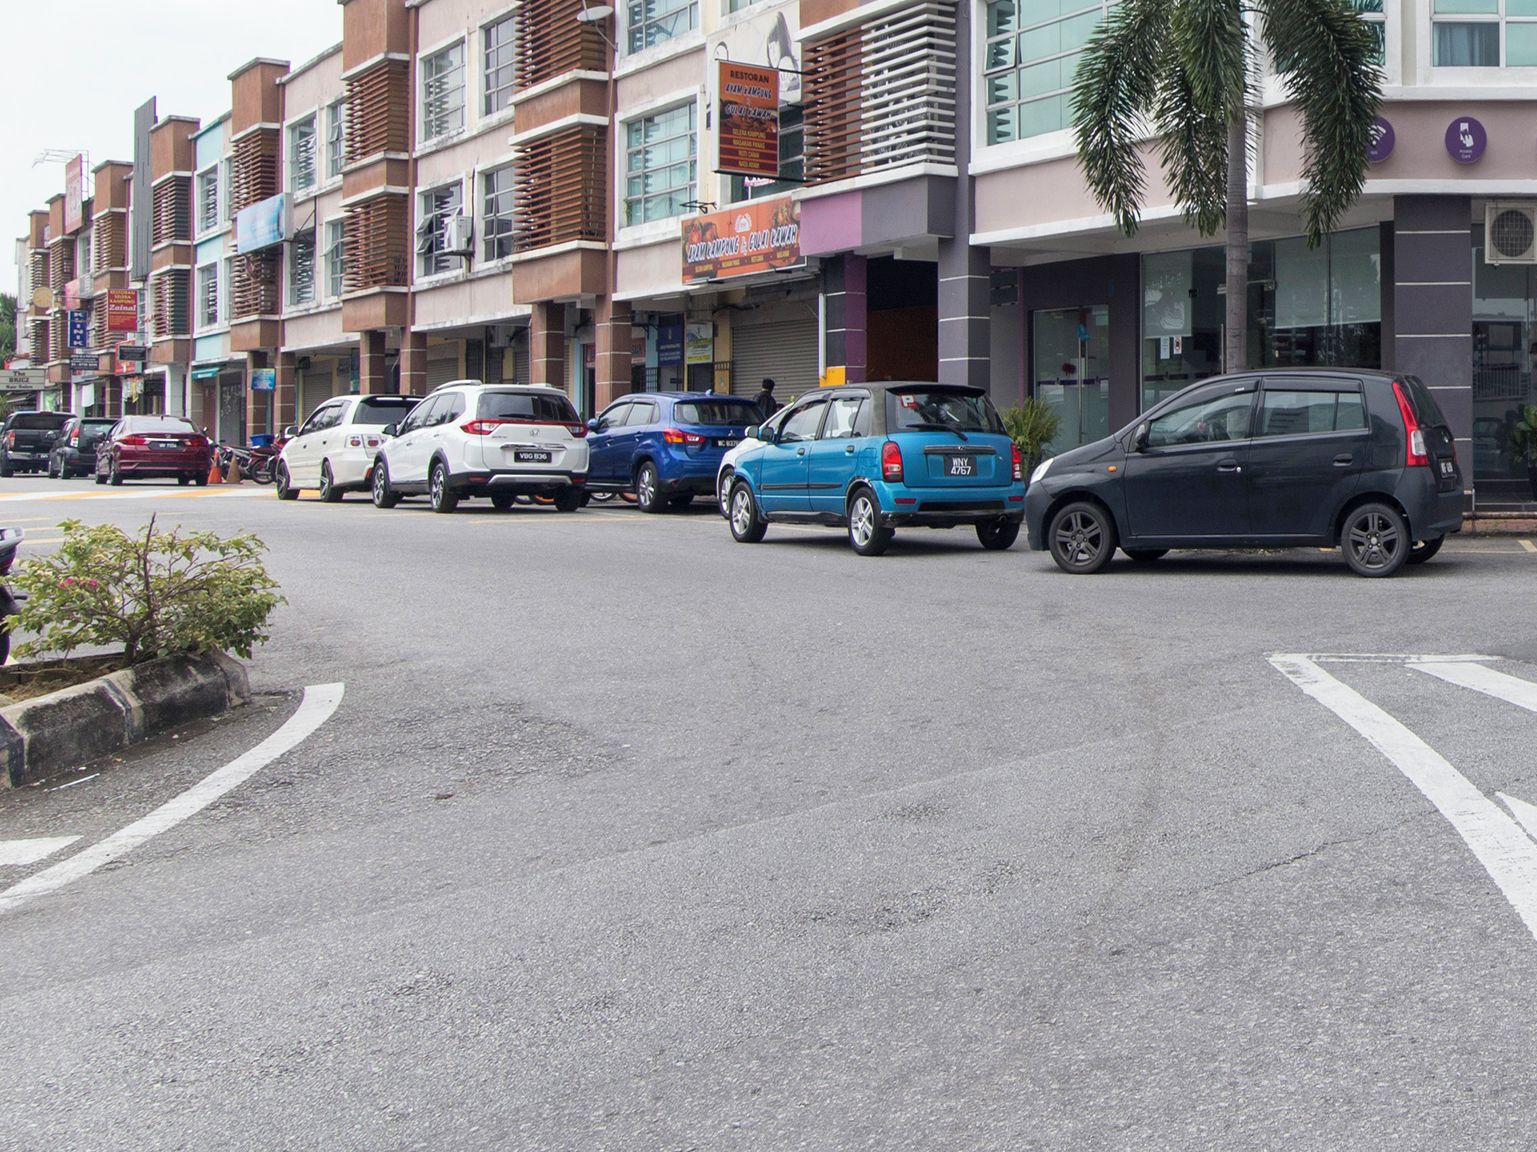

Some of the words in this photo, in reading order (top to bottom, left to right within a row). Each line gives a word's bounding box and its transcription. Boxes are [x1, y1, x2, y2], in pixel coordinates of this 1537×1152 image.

[730, 70, 769, 83] RESTORAN
[73, 312, 84, 346] KLINIK
[902, 394, 914, 407] P
[952, 457, 968, 466] WNY
[950, 465, 972, 475] 4767
